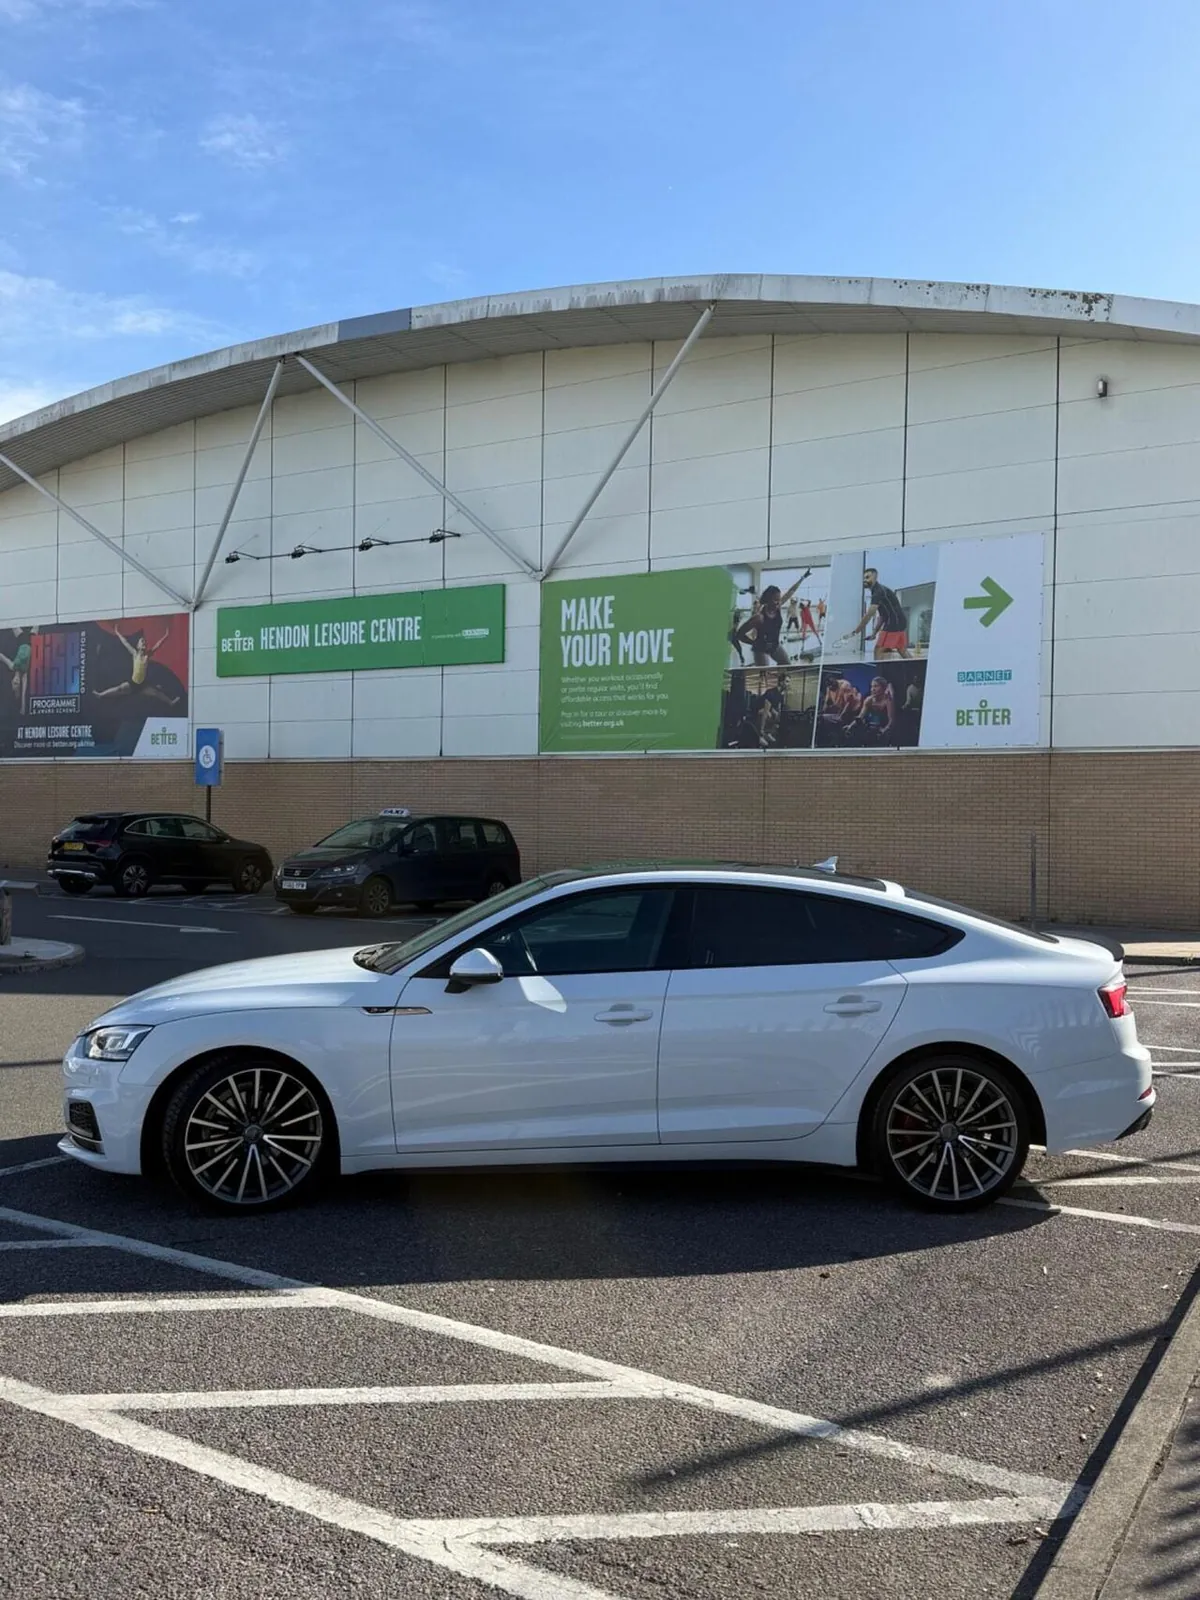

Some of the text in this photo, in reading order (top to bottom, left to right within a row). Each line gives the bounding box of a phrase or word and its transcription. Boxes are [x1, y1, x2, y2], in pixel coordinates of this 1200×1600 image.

[561, 595, 615, 632] MAKE
[221, 616, 422, 652] BETTER HENDON LEISURE CENTRE
[560, 628, 674, 668] YOUR MOVE
[957, 669, 1012, 682] BARNET
[33, 698, 76, 708] PROGRAMME
[582, 719, 624, 728] better.org.uk
[956, 708, 1011, 726] BETTER
[24, 726, 46, 739] HENDON
[47, 725, 70, 738] LEISURE
[70, 725, 92, 738] CENTRE
[151, 732, 177, 745] BETTER
